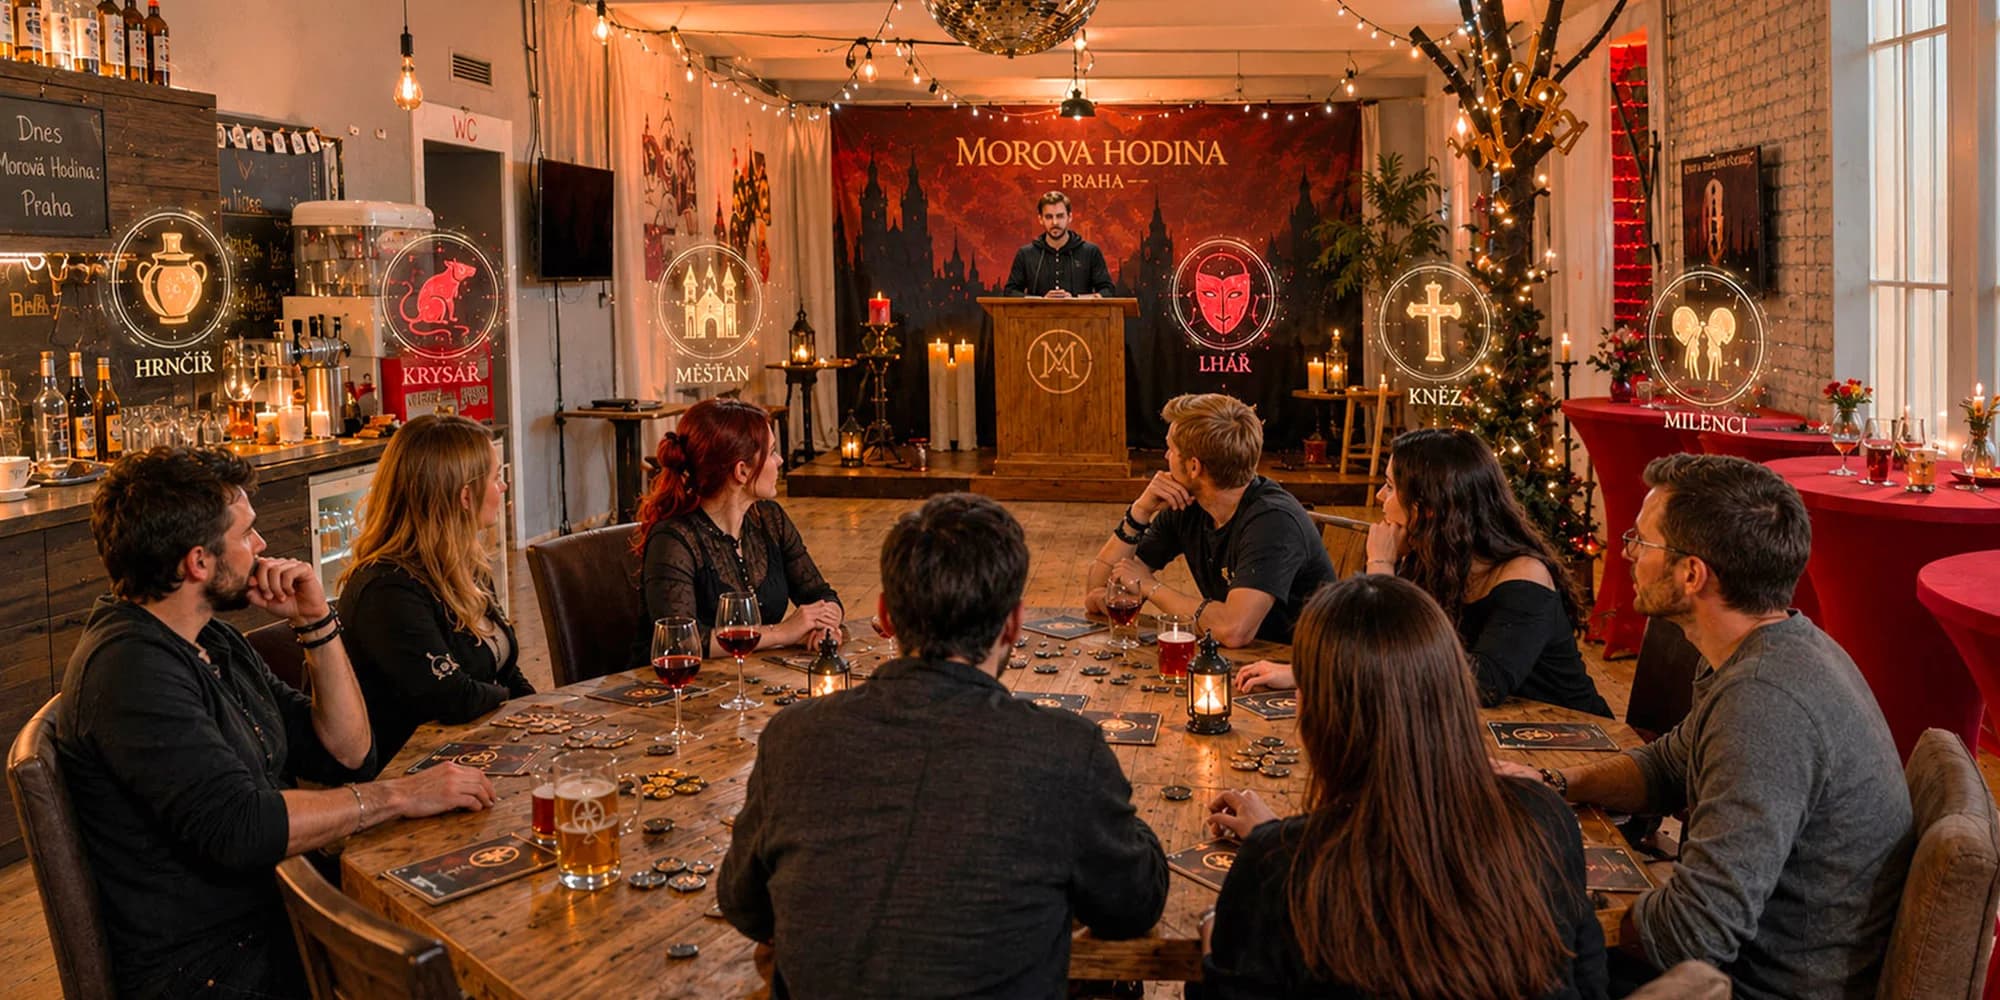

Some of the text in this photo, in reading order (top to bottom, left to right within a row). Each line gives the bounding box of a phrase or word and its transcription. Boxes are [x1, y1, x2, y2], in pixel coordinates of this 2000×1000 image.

[16, 114, 63, 144] Dnes
[452, 114, 478, 142] WC
[956, 136, 1229, 170] MOROVA HODINA
[50, 156, 101, 180] Hodina:
[1062, 173, 1125, 189] PRAHA
[21, 188, 74, 218] Praha
